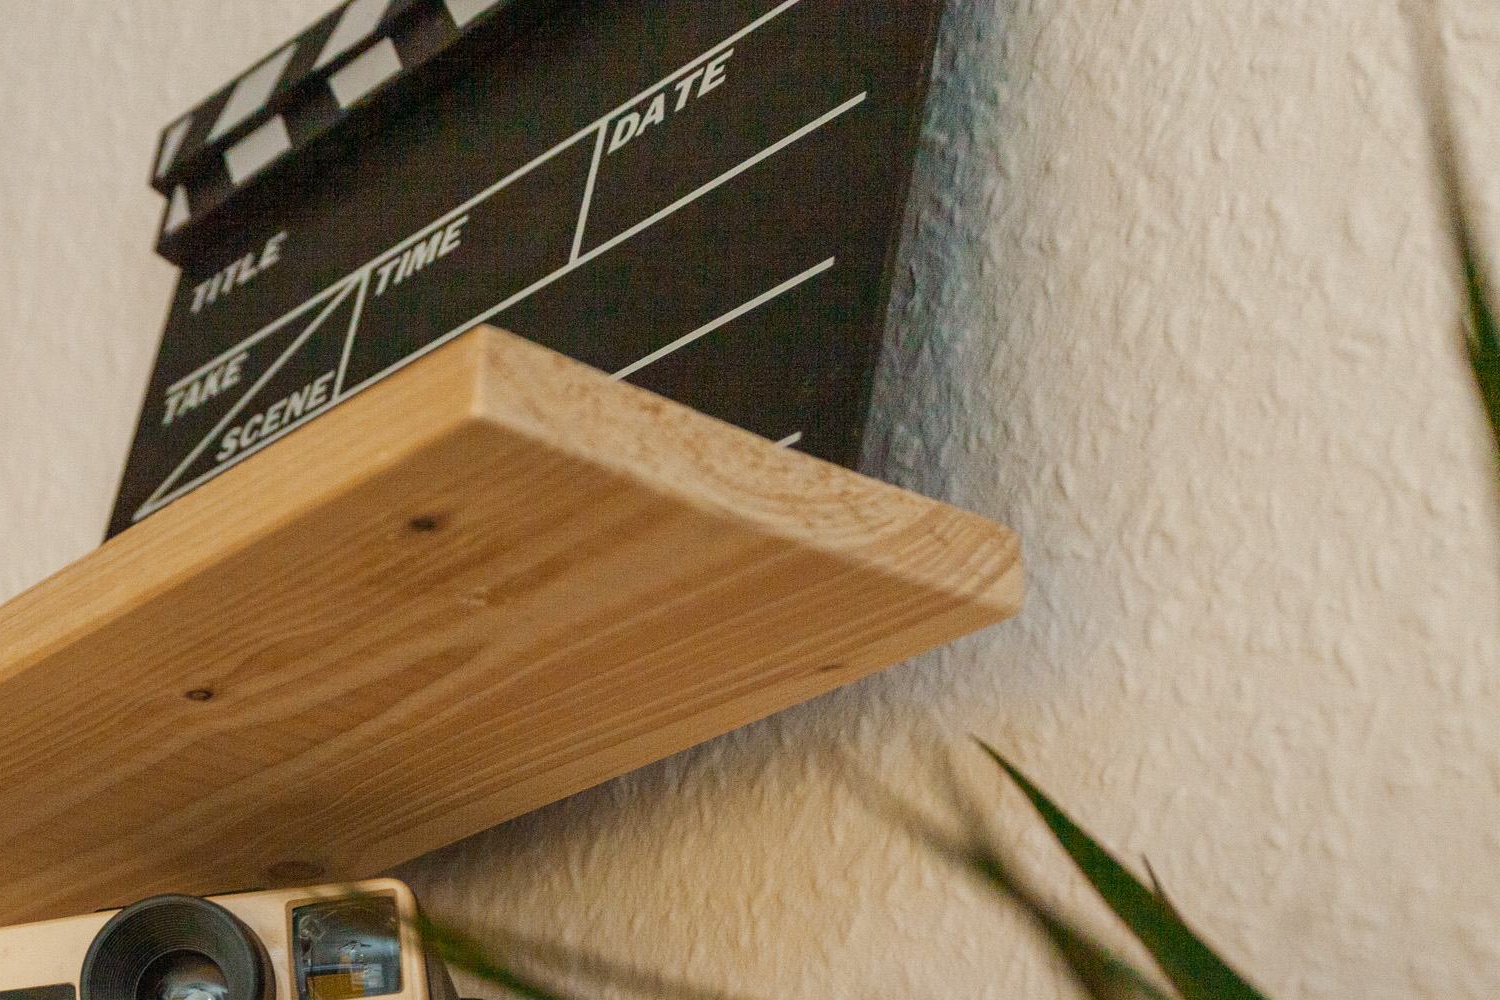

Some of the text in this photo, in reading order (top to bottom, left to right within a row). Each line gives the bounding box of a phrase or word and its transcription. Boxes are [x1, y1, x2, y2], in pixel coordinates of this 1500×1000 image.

[607, 47, 735, 155] DATE
[190, 231, 288, 313] TITLE
[374, 214, 469, 297] TIME
[162, 351, 248, 427] TAKE
[215, 370, 336, 462] SCENE
